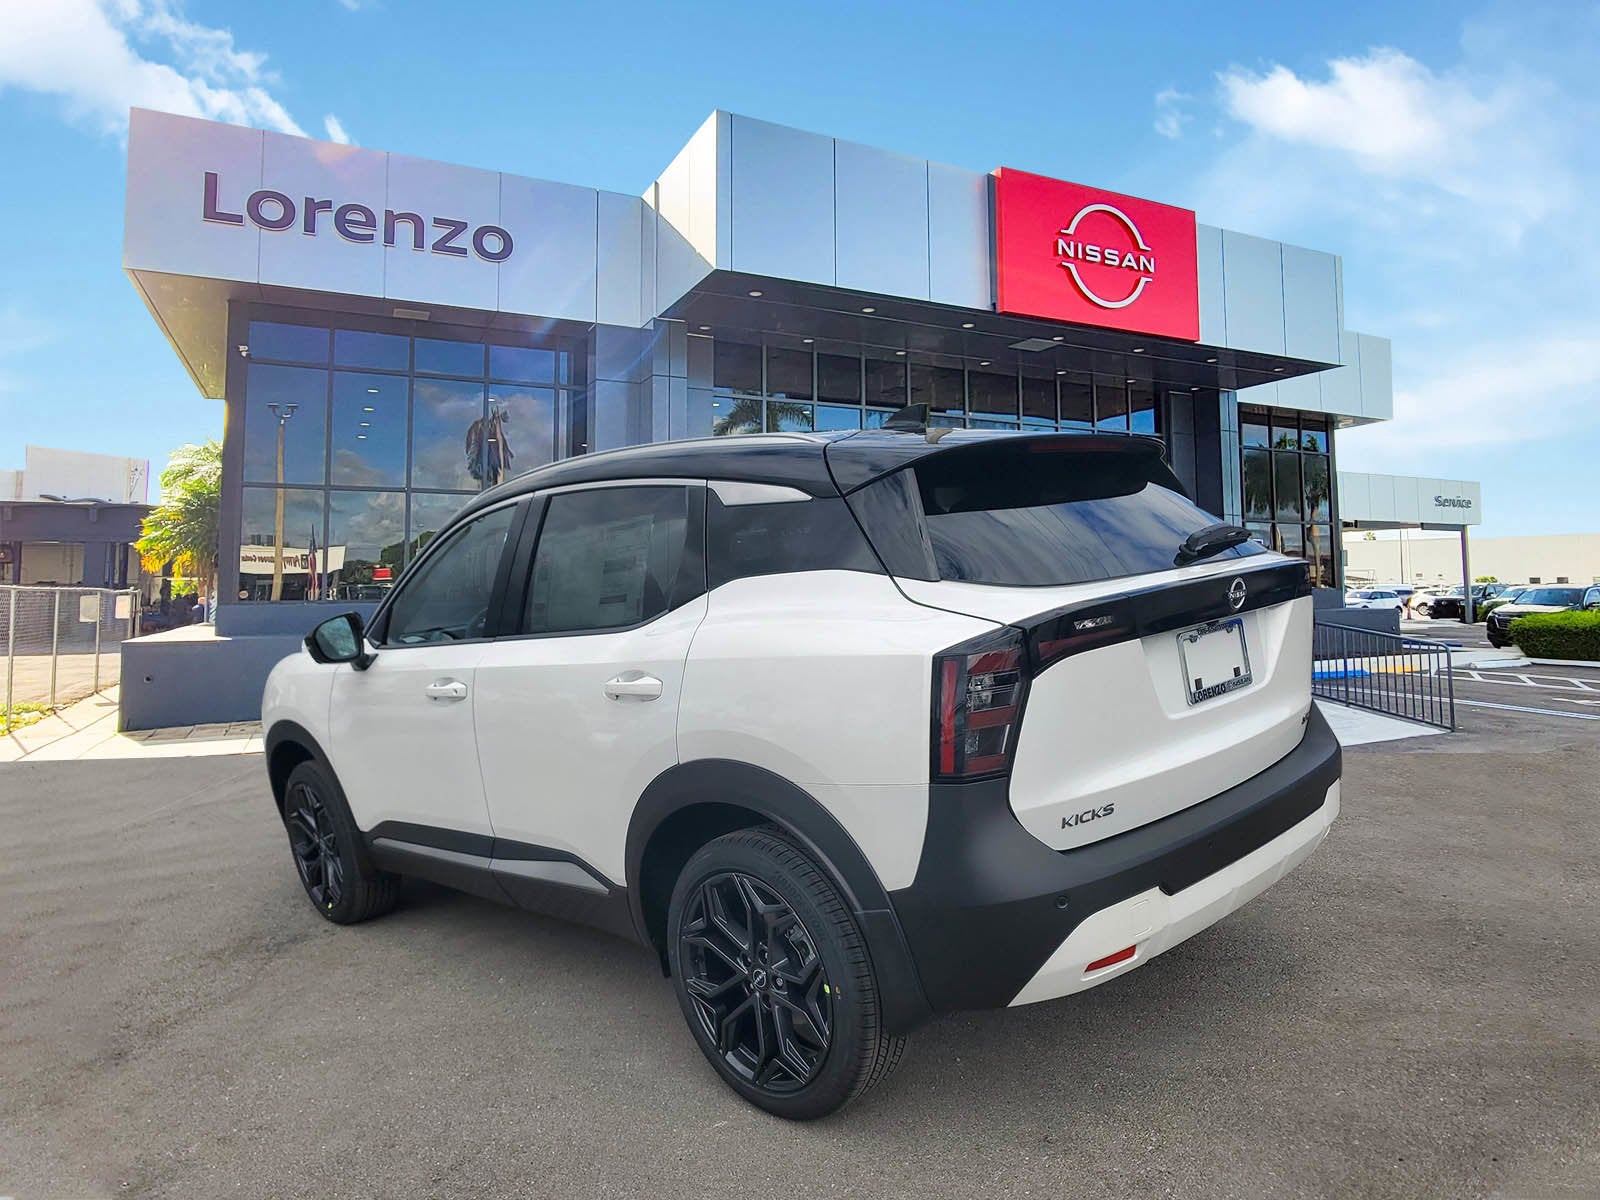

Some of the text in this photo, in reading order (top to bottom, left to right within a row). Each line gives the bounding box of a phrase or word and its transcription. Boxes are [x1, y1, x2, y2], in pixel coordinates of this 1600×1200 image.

[202, 171, 514, 262] Lorenzo
[1057, 238, 1155, 273] NISSAN
[1433, 495, 1472, 509] Service
[1193, 683, 1227, 703] LORENZO
[1061, 802, 1115, 829] KICKS
